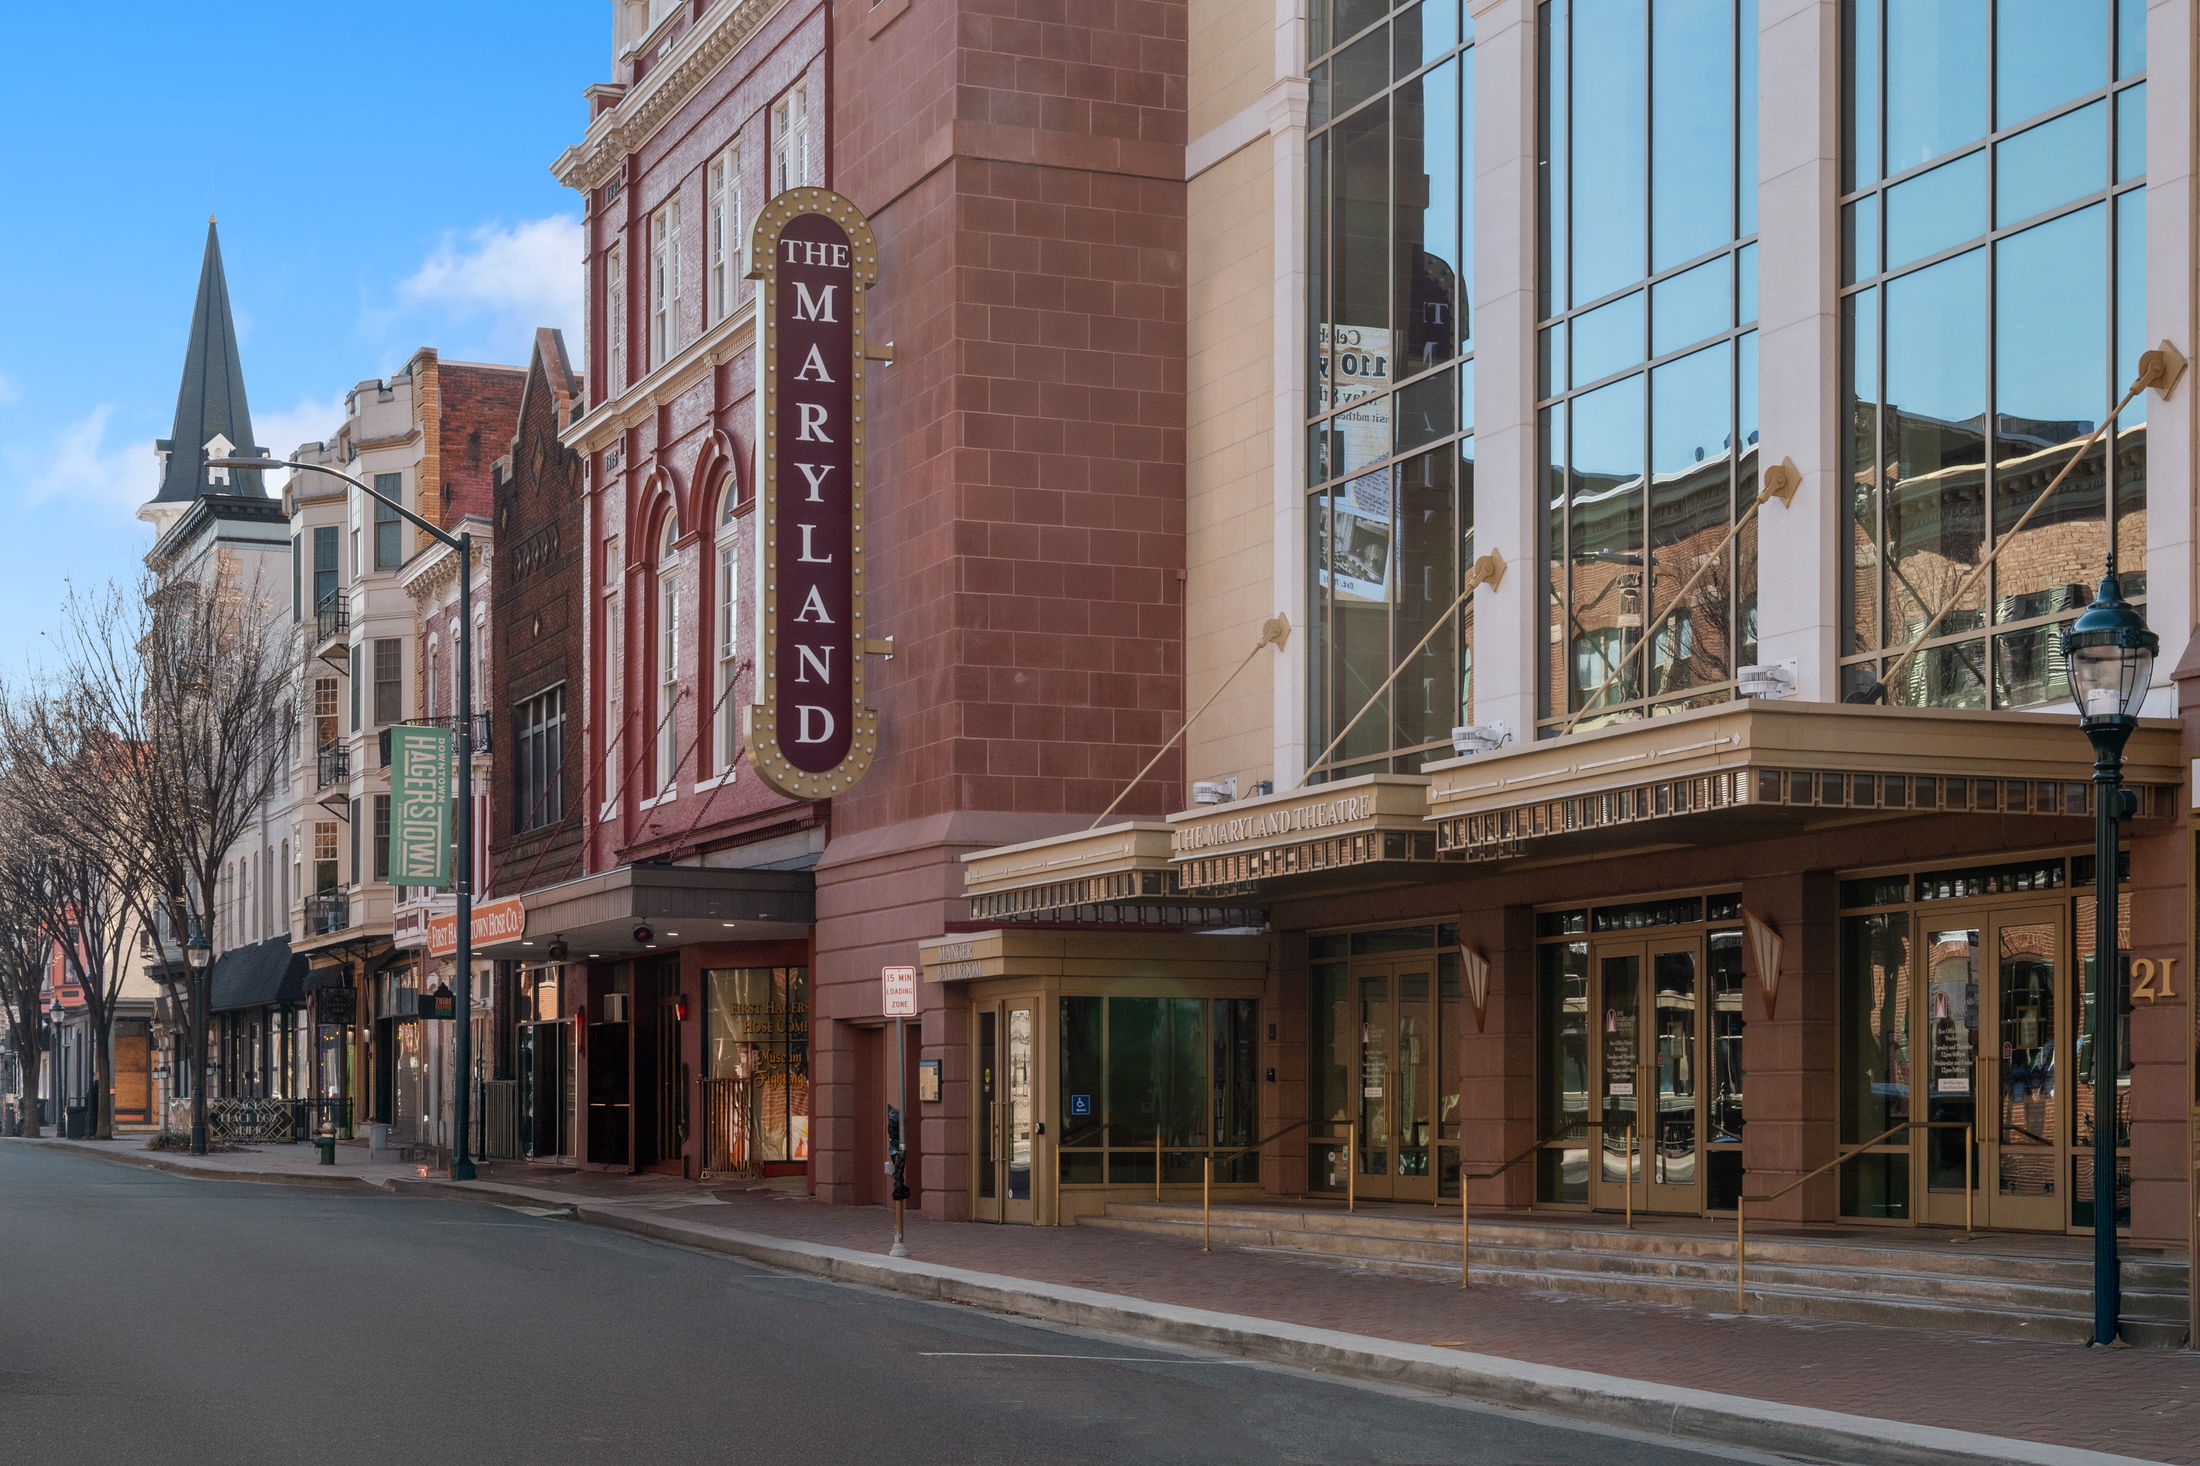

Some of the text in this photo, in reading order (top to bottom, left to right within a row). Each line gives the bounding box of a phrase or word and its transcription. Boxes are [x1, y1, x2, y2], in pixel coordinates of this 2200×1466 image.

[781, 239, 850, 269] THE
[792, 282, 838, 744] MARYLAND
[437, 737, 445, 803] DOWNTOWN
[403, 735, 441, 878] HAGERSTOWN
[1175, 795, 1370, 850] THE MARYLAND THEATRE
[886, 973, 912, 982] 15 MIN
[937, 960, 982, 980] BALLROOM
[2131, 957, 2177, 1003] 21
[886, 987, 913, 995] LOADING
[731, 1002, 762, 1016] FIRST
[892, 1000, 908, 1008] ZONE
[743, 1020, 773, 1034] HOSE
